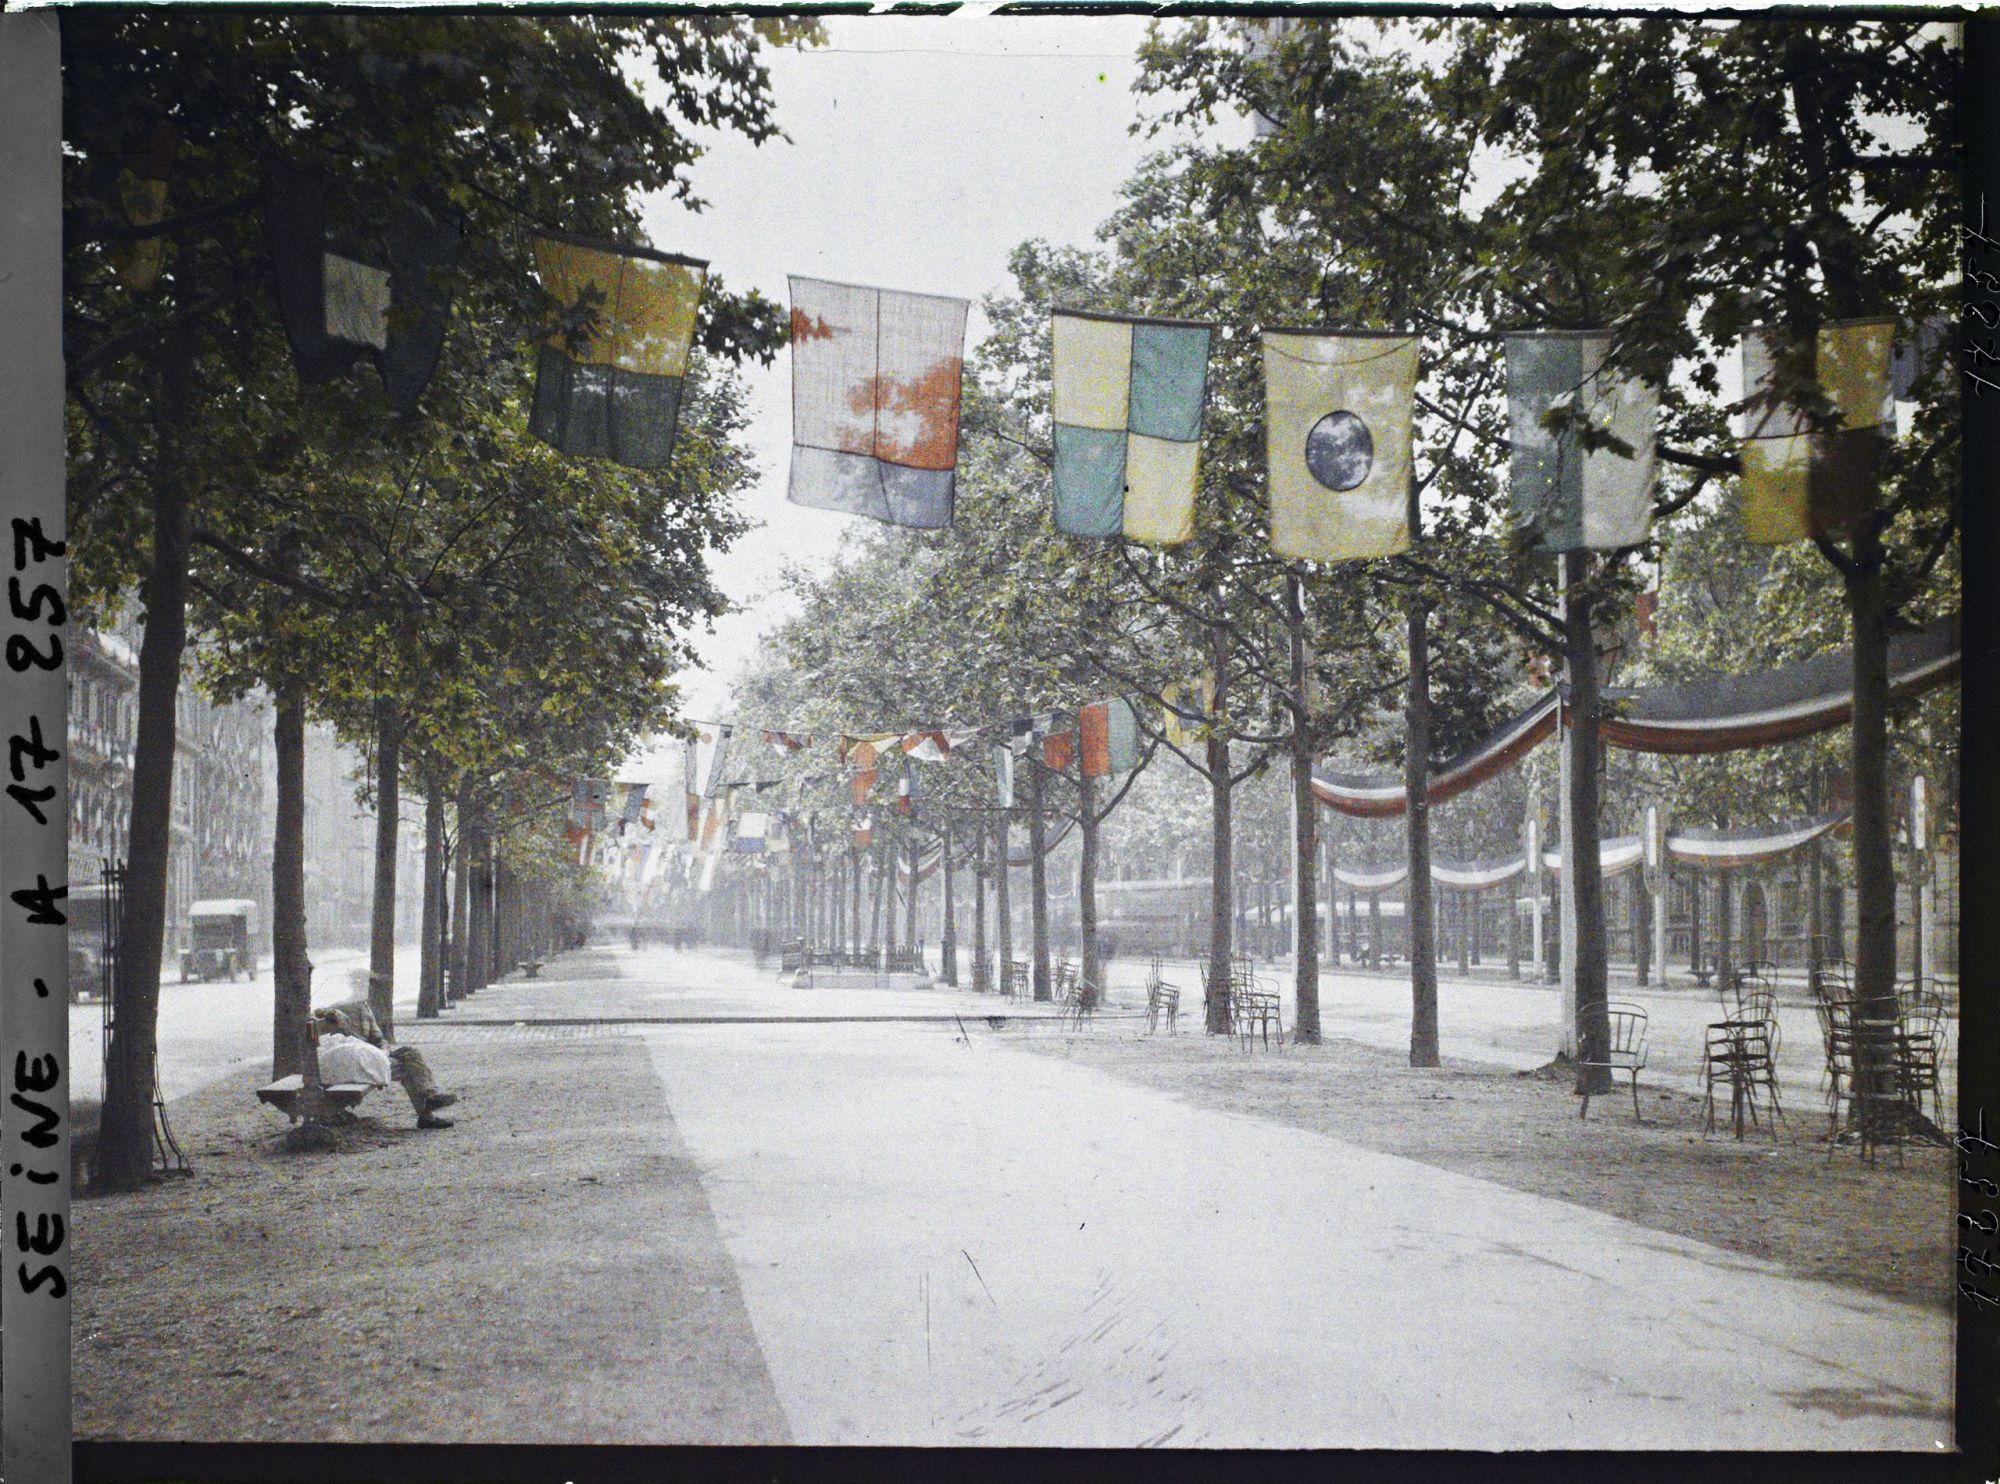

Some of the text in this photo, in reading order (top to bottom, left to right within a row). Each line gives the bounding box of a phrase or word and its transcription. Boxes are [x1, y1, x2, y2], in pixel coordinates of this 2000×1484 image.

[5, 517, 67, 673] 257
[5, 715, 61, 826] 17
[10, 874, 67, 927] A
